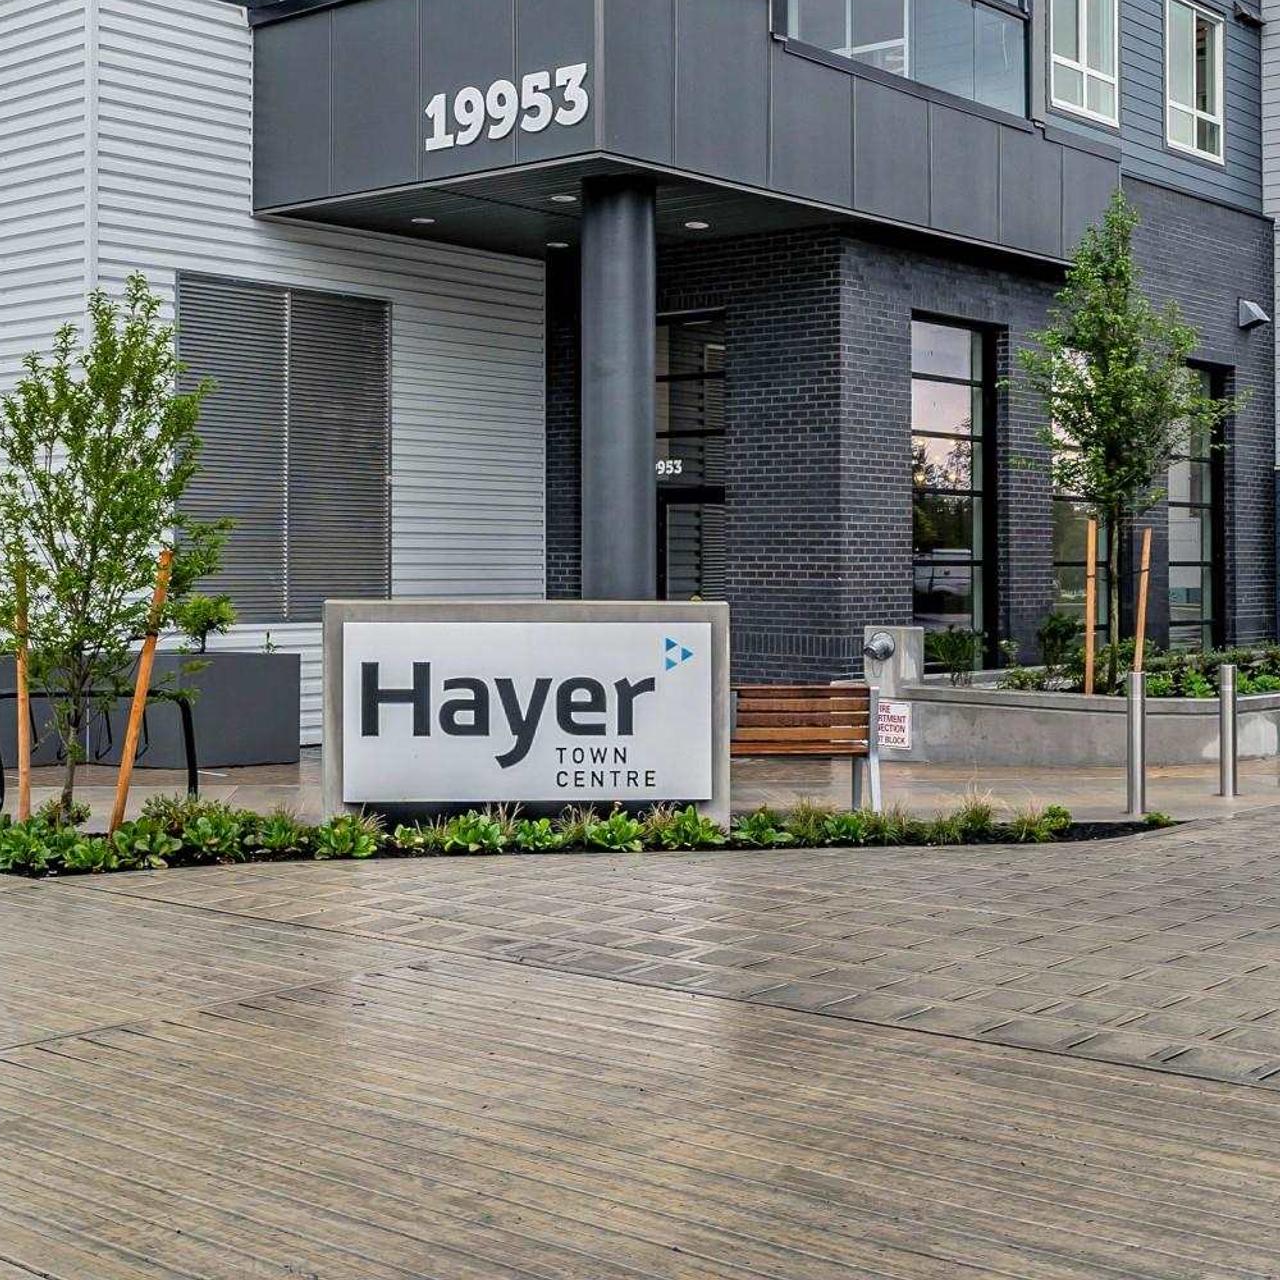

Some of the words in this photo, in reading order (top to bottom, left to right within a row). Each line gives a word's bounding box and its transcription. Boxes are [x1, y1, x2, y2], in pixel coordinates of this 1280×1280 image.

[425, 63, 589, 151] 19953
[655, 460, 682, 475] 953
[360, 661, 656, 768] Hayer
[557, 747, 627, 764] TOWN
[556, 770, 656, 787] CENTRE
